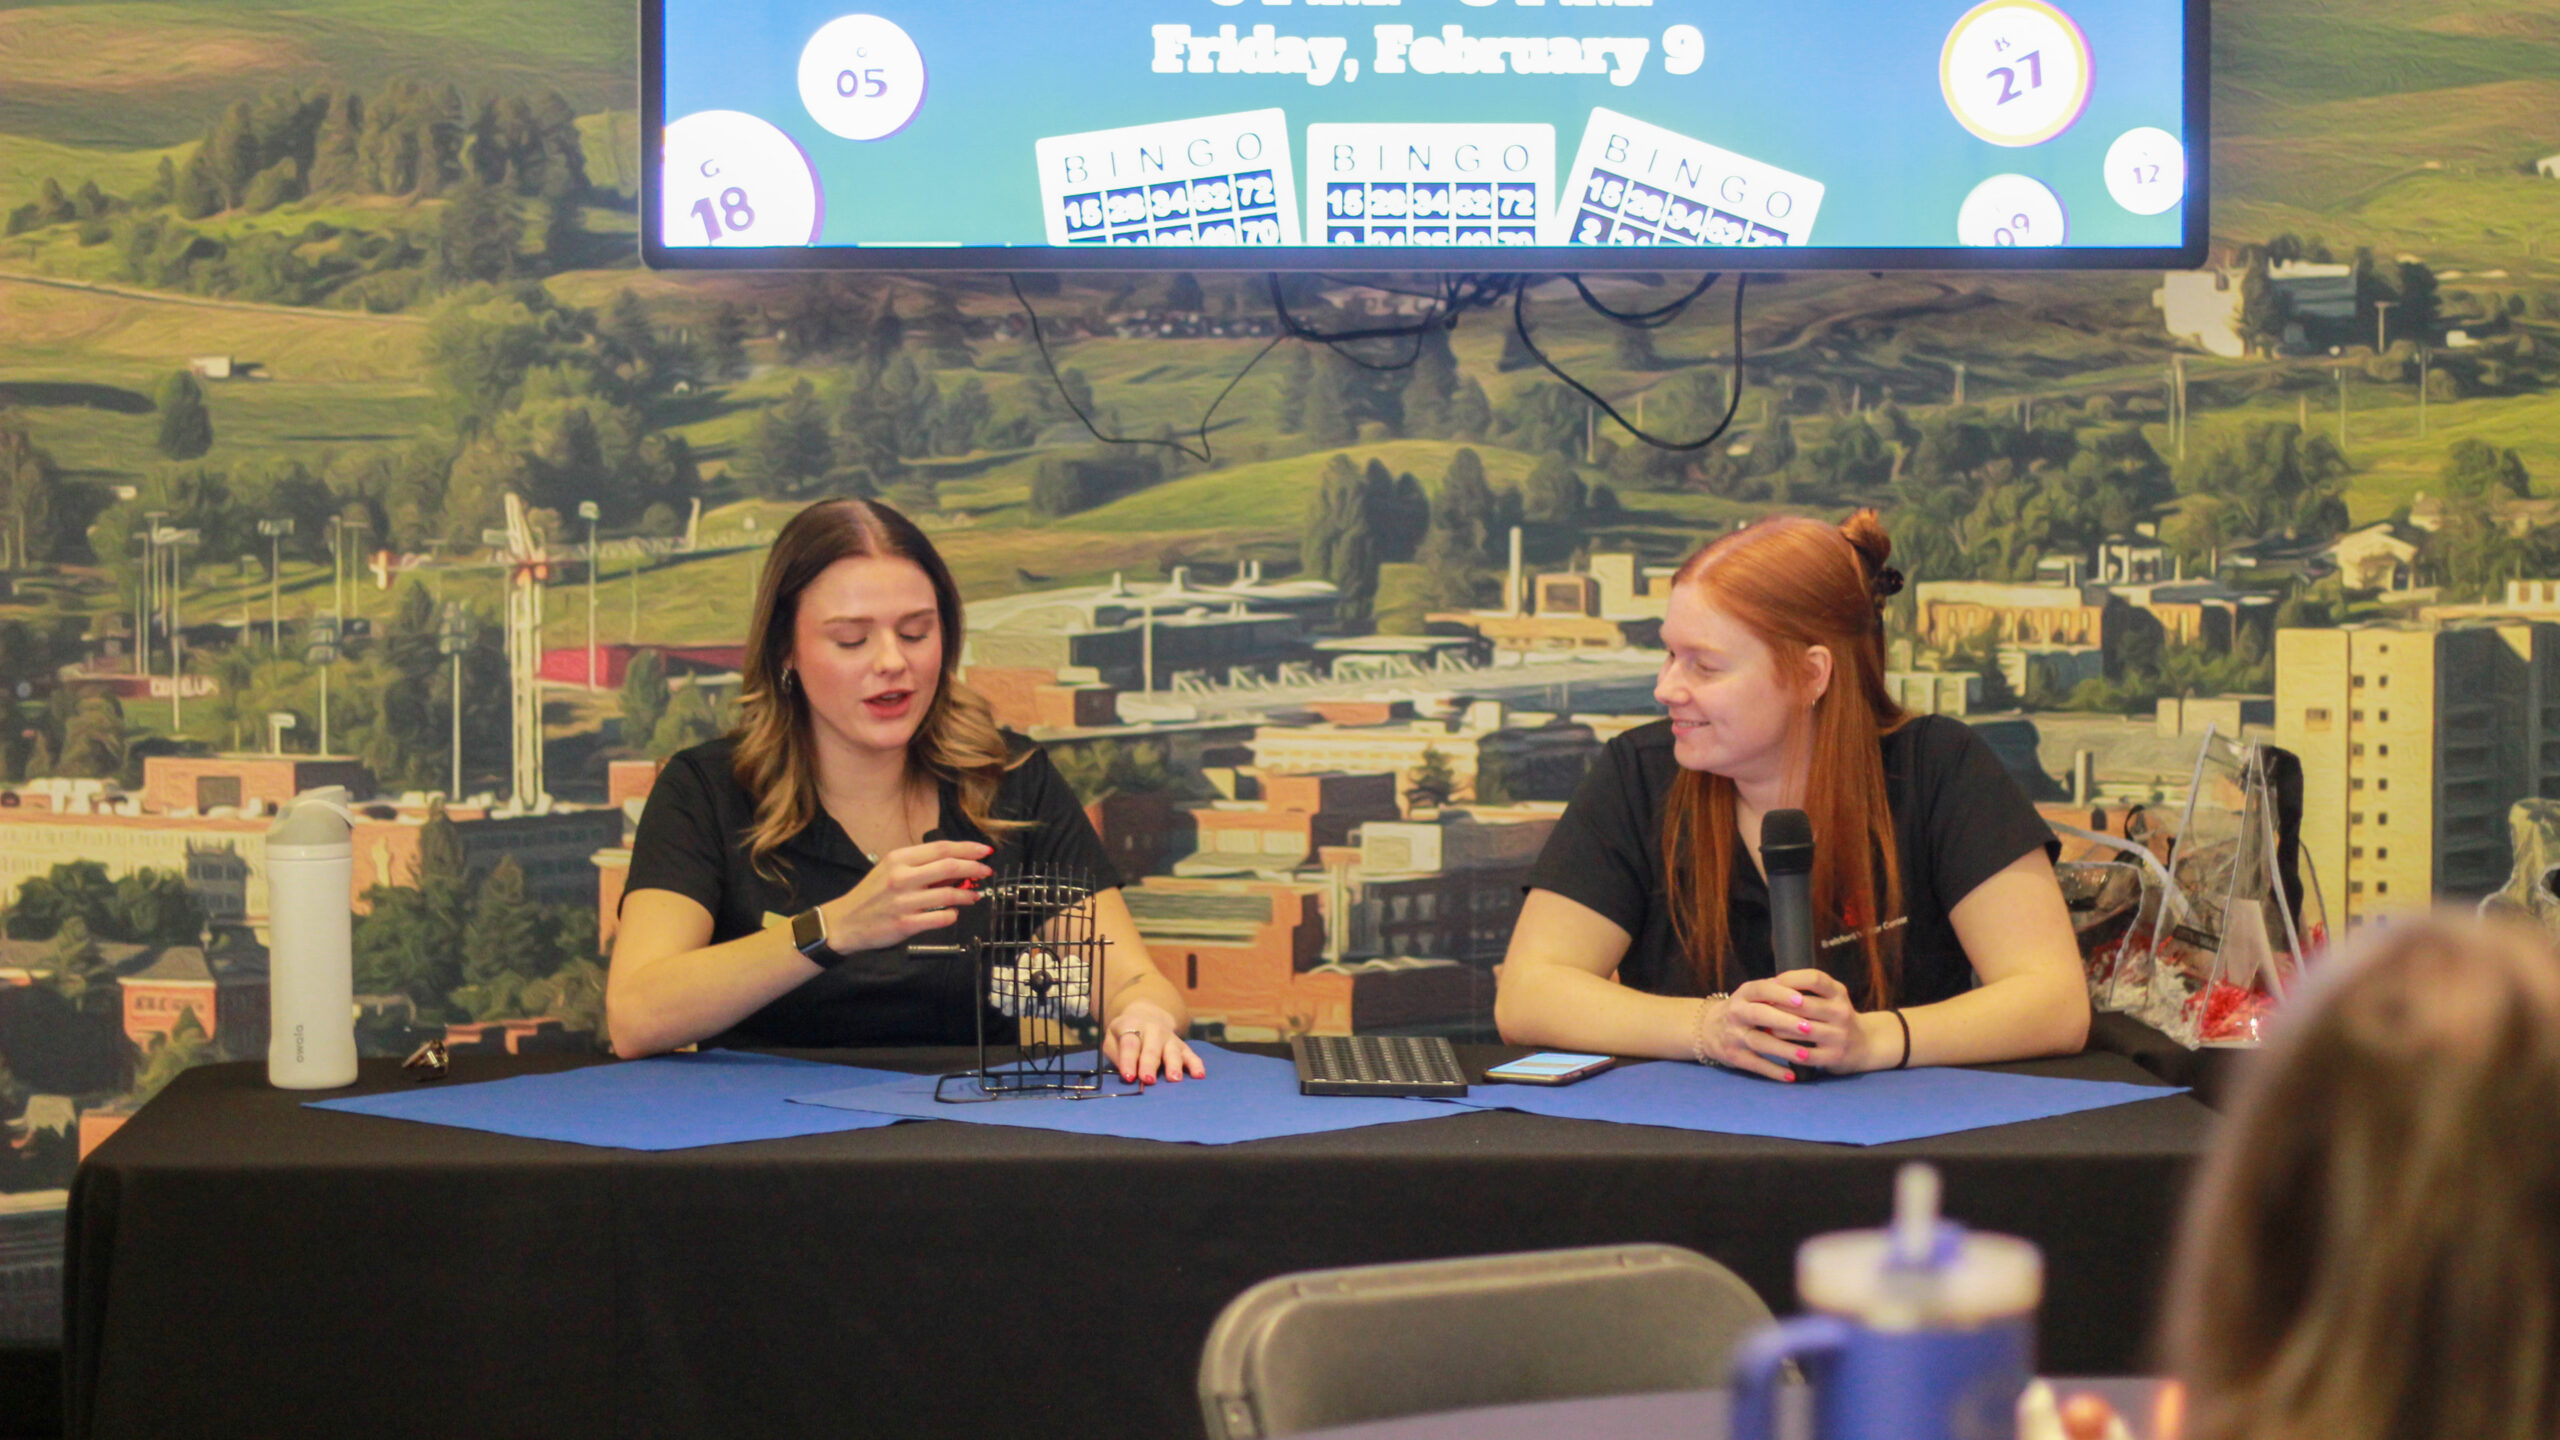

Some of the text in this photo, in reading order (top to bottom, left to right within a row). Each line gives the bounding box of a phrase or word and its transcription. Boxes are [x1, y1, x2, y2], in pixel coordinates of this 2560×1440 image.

[1151, 23, 1705, 87] Friday, February 9
[836, 68, 888, 98] 05
[1986, 50, 2042, 106] 27
[1064, 132, 1262, 183] BINGO
[1333, 144, 1529, 172] BINGO
[1605, 134, 1793, 218] BINGO
[2132, 164, 2160, 184] 12
[1236, 177, 1275, 205] 72
[1498, 190, 1534, 215] 72
[690, 187, 755, 241] 18
[1242, 219, 1280, 245] 70
